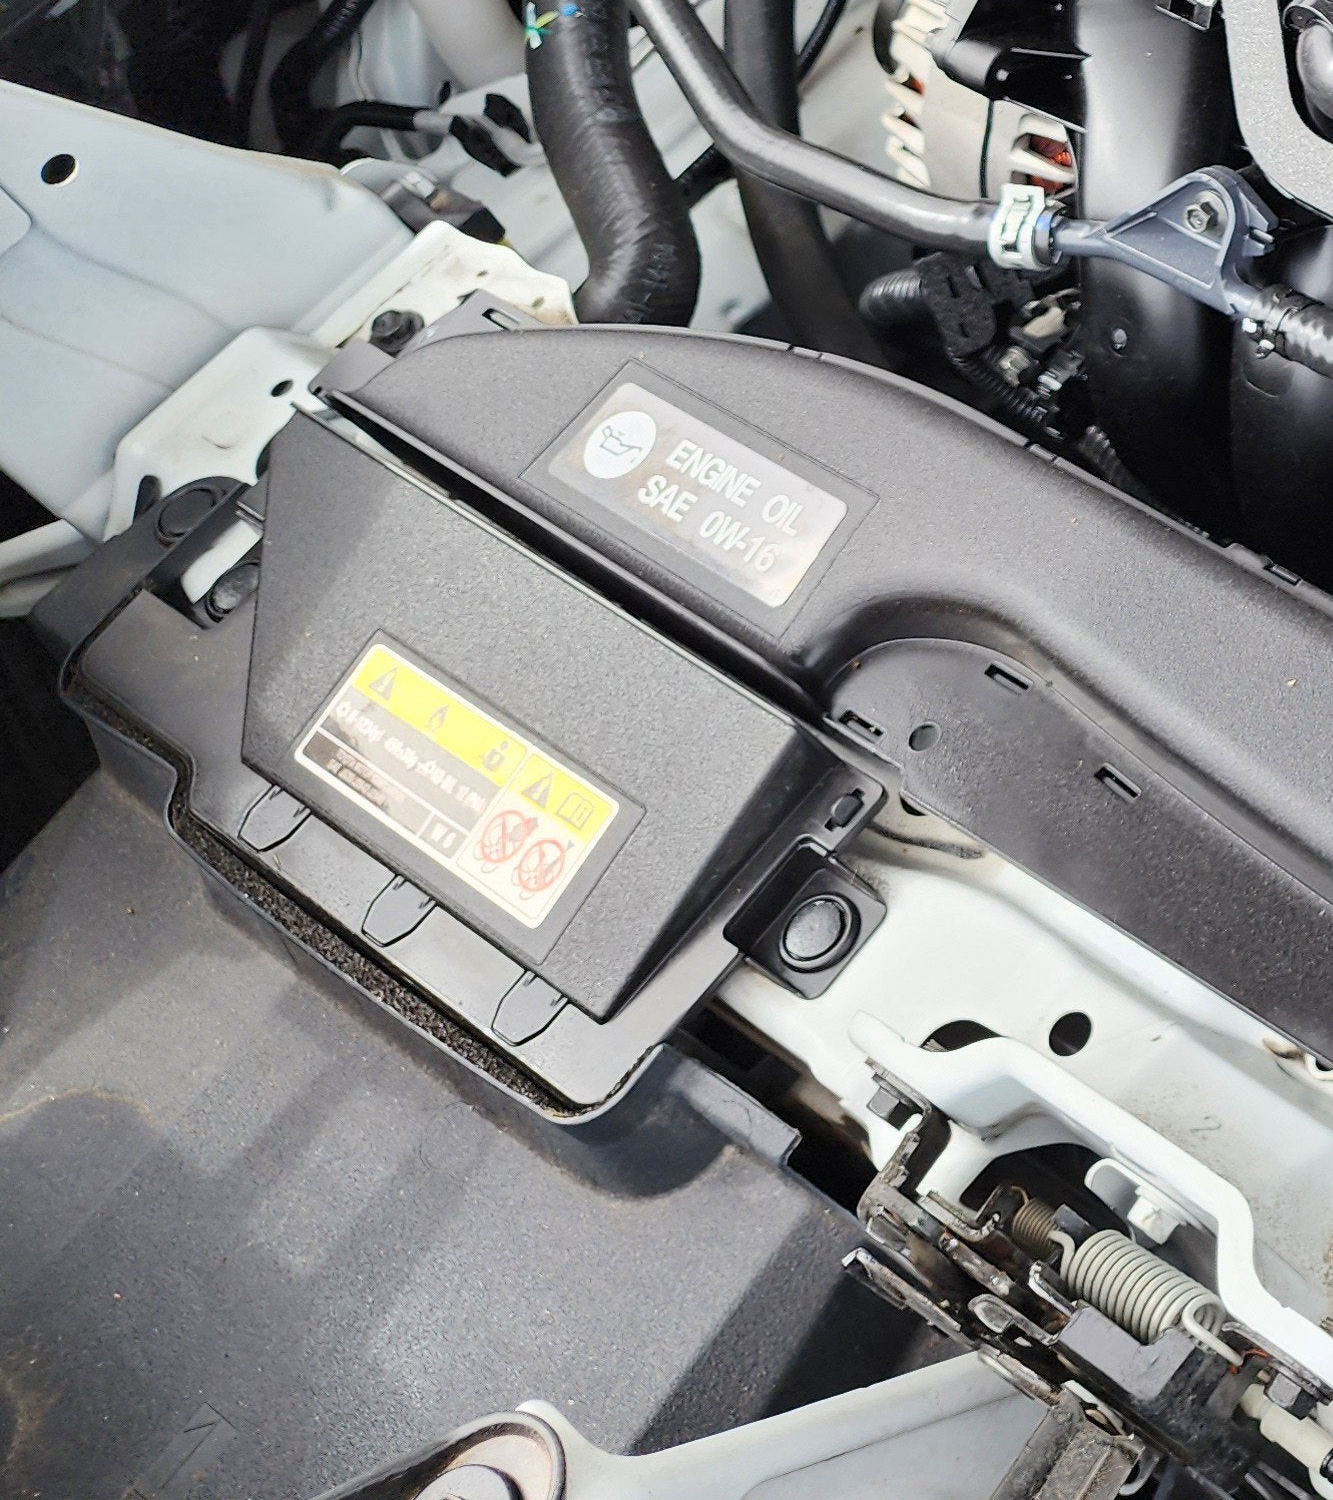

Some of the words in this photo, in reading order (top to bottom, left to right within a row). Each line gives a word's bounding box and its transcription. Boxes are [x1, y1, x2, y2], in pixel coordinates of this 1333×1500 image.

[633, 471, 699, 524] SAE
[695, 507, 784, 575] 0W-16
[663, 437, 763, 508] ENGINE
[757, 489, 812, 537] OIL
